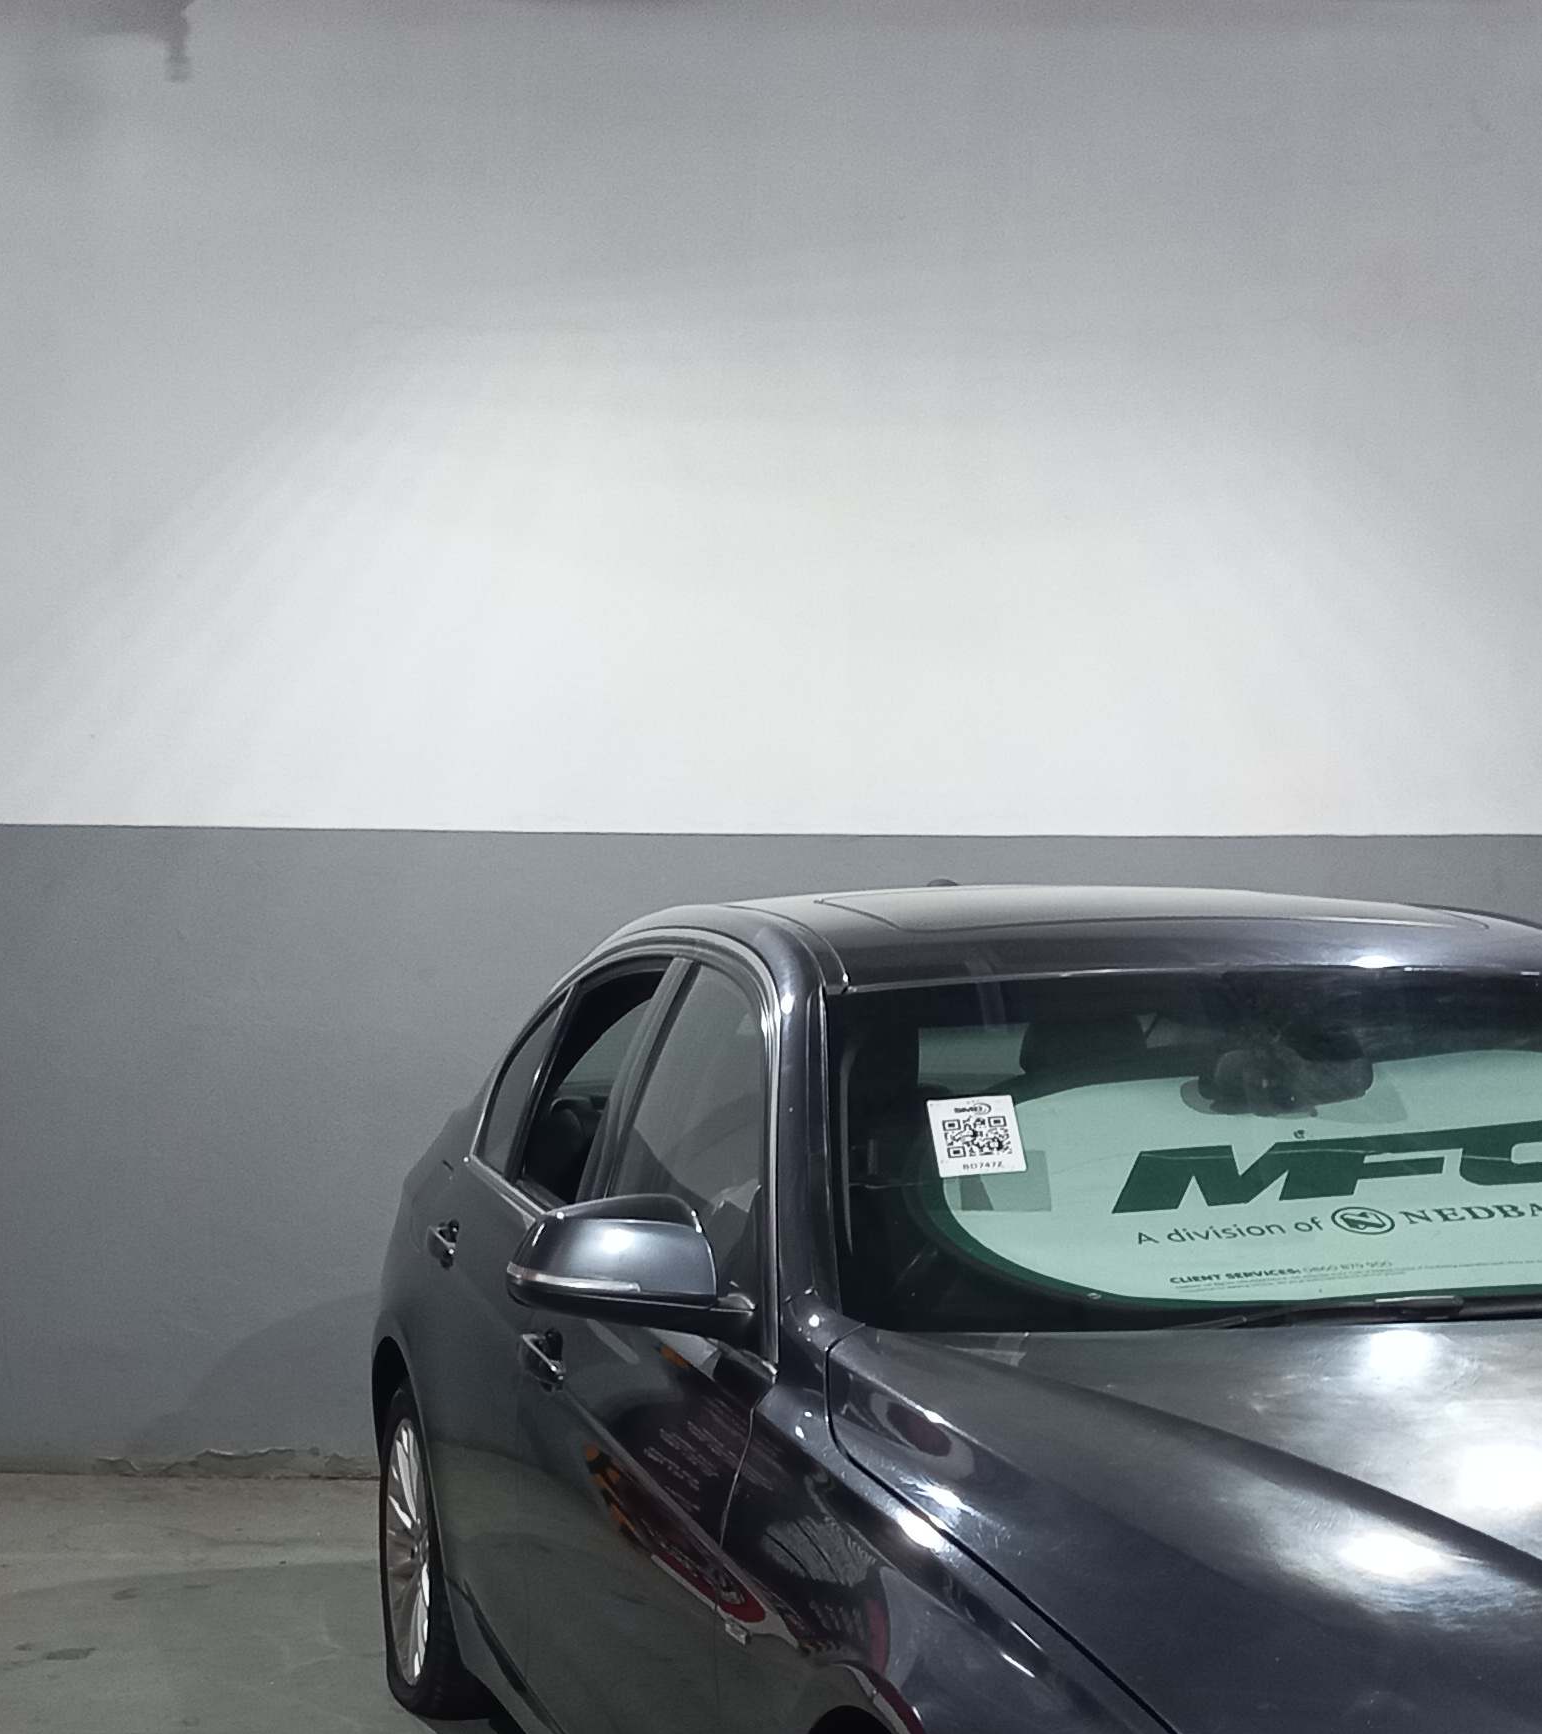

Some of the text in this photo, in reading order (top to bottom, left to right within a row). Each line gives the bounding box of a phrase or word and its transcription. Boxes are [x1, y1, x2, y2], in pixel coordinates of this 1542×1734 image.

[1137, 1232, 1159, 1246] A
[1168, 1219, 1288, 1243] division
[1295, 1216, 1323, 1234] of
[1169, 1274, 1221, 1285] CLIENT
